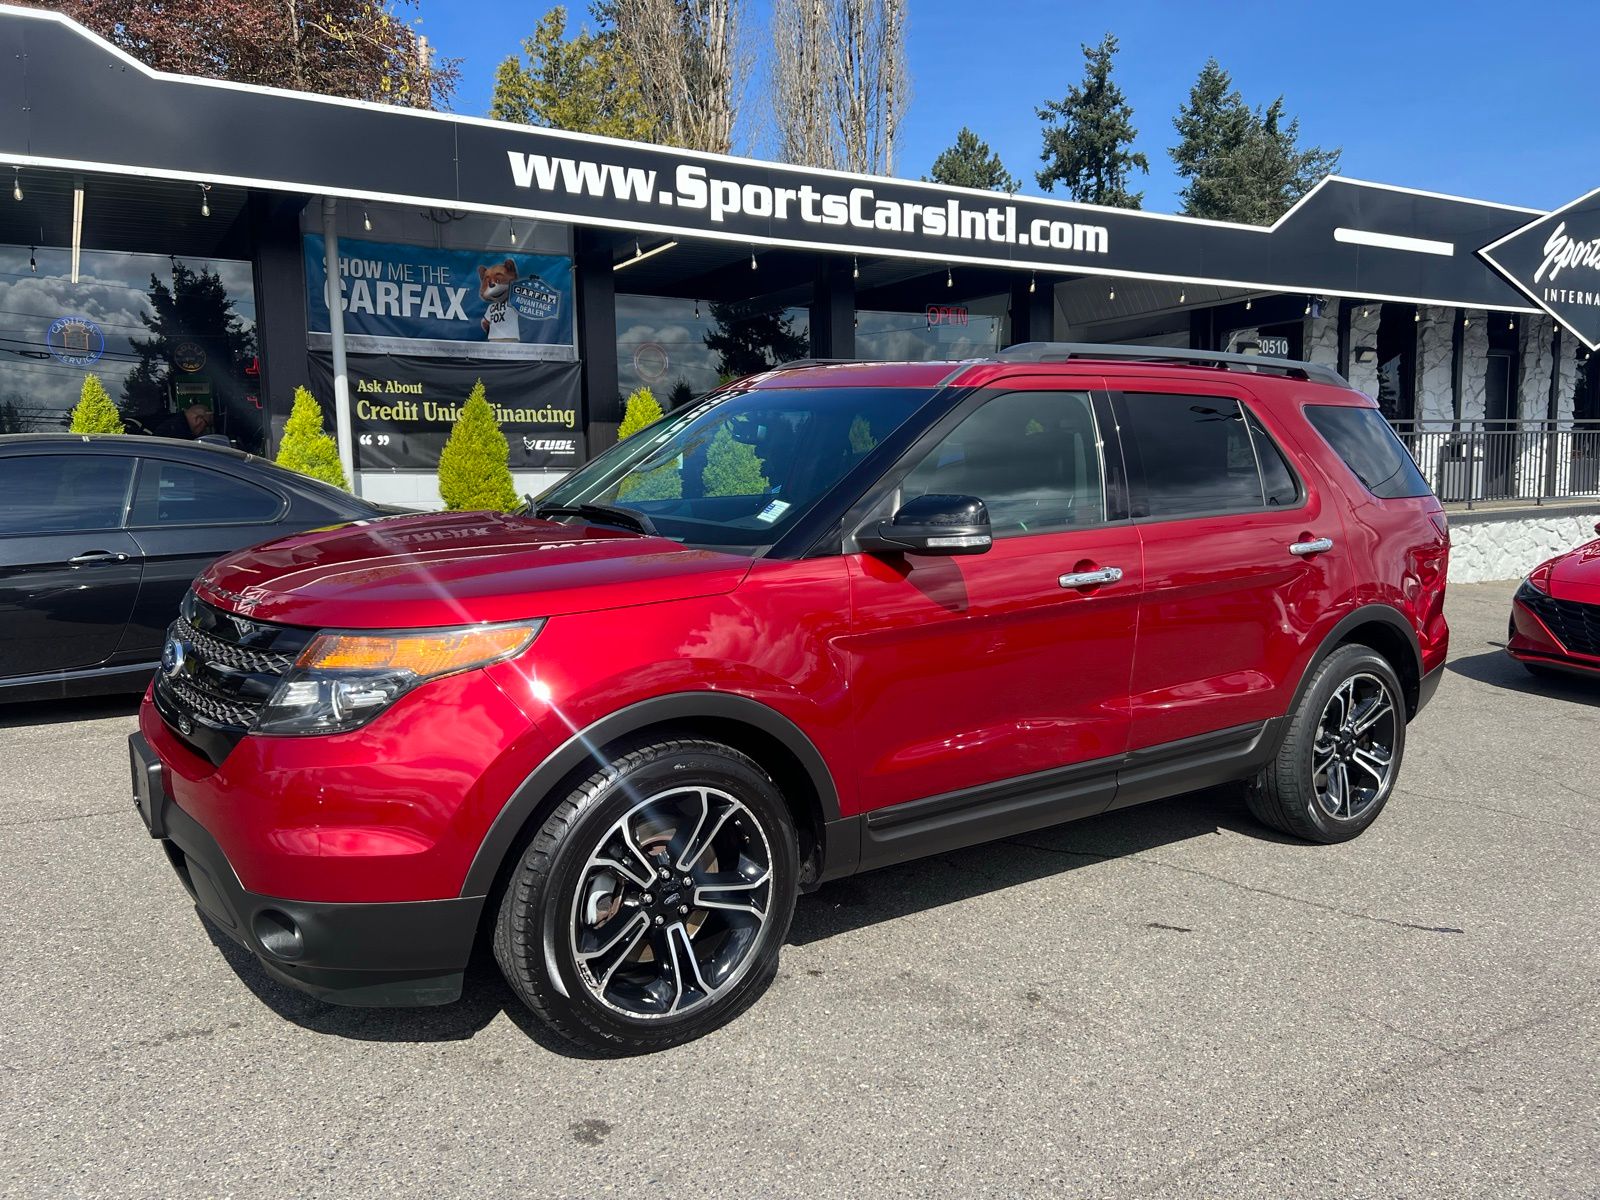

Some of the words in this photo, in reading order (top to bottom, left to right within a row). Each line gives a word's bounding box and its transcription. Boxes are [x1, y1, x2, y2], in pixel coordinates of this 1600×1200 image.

[507, 151, 1109, 253] www.SportsCarsIntl.com
[323, 256, 382, 279] HOW
[388, 262, 414, 282] ME
[418, 265, 450, 285] THE
[514, 286, 556, 304] CARFAX
[515, 296, 552, 312] ADVANTAGE
[490, 301, 507, 313] CAR
[519, 305, 545, 317] DEALER
[928, 306, 968, 327] OPEN
[357, 380, 383, 393] Ask
[385, 381, 422, 394] About
[356, 400, 418, 421] Credit
